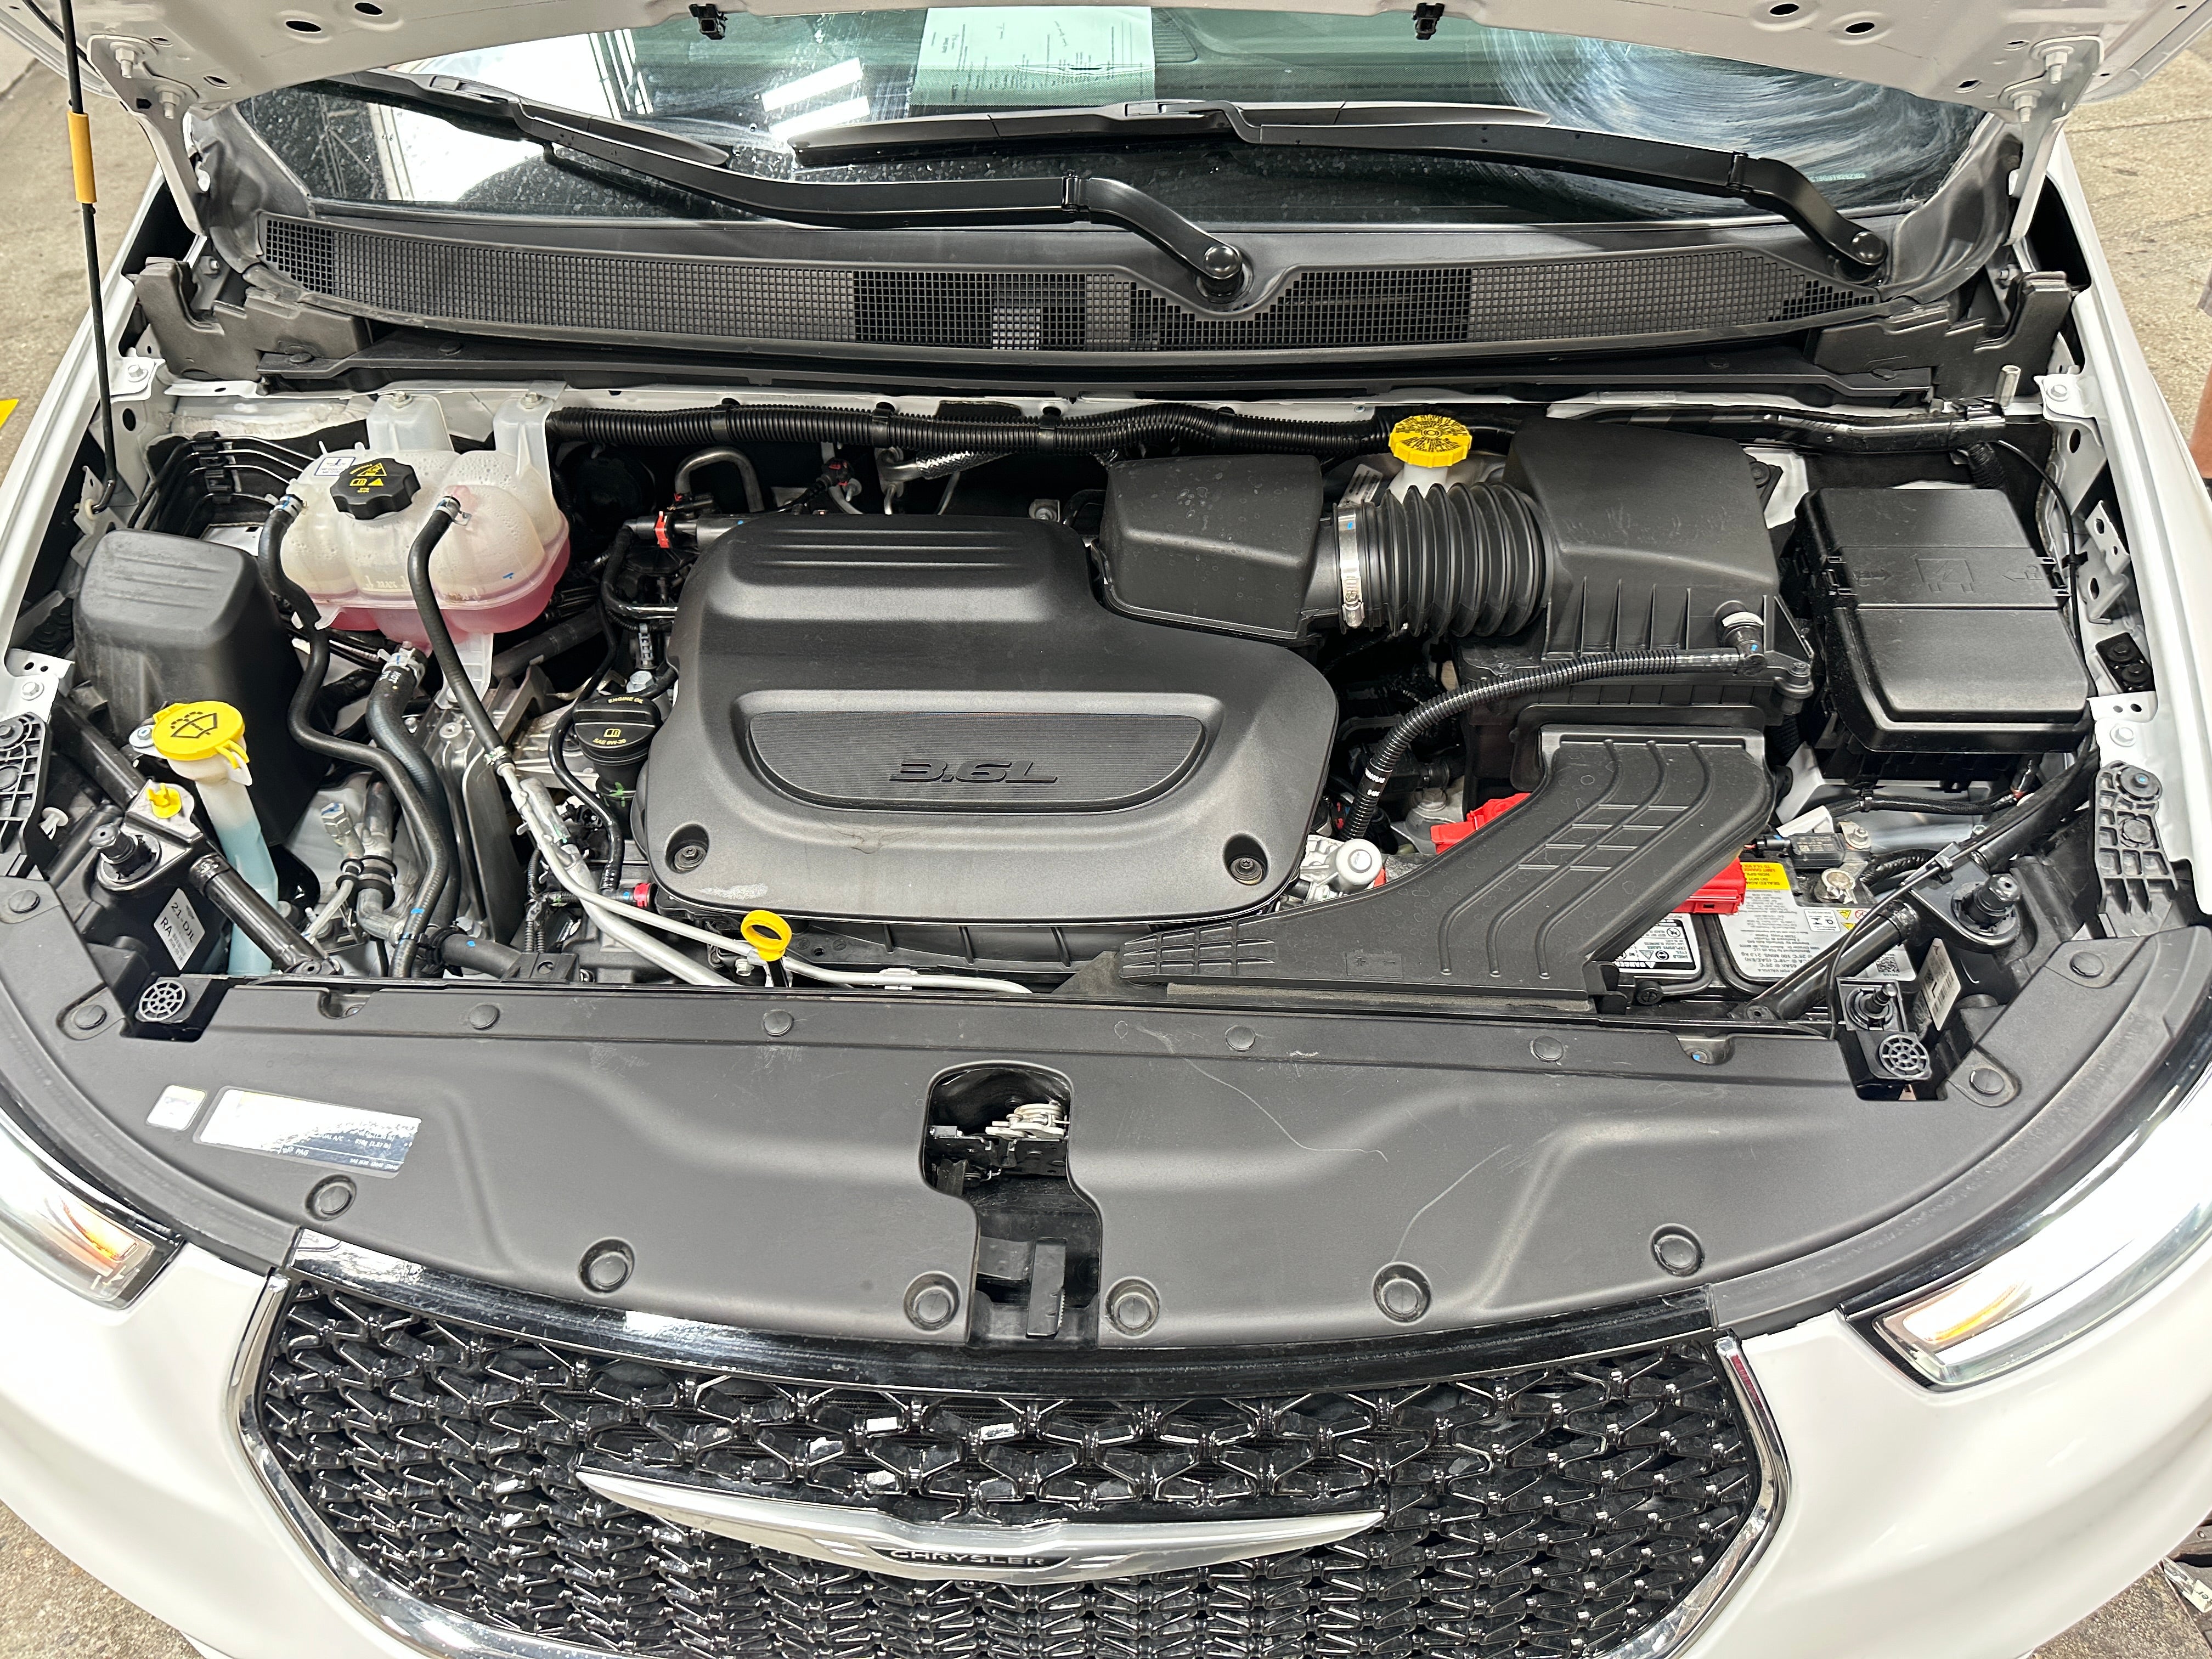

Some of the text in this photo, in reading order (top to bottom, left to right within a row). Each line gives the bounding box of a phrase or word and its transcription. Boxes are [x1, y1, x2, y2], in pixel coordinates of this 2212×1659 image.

[889, 759, 1058, 783] 3.6L
[160, 916, 173, 937] RA
[889, 1550, 1045, 1566] CHRYSLER
